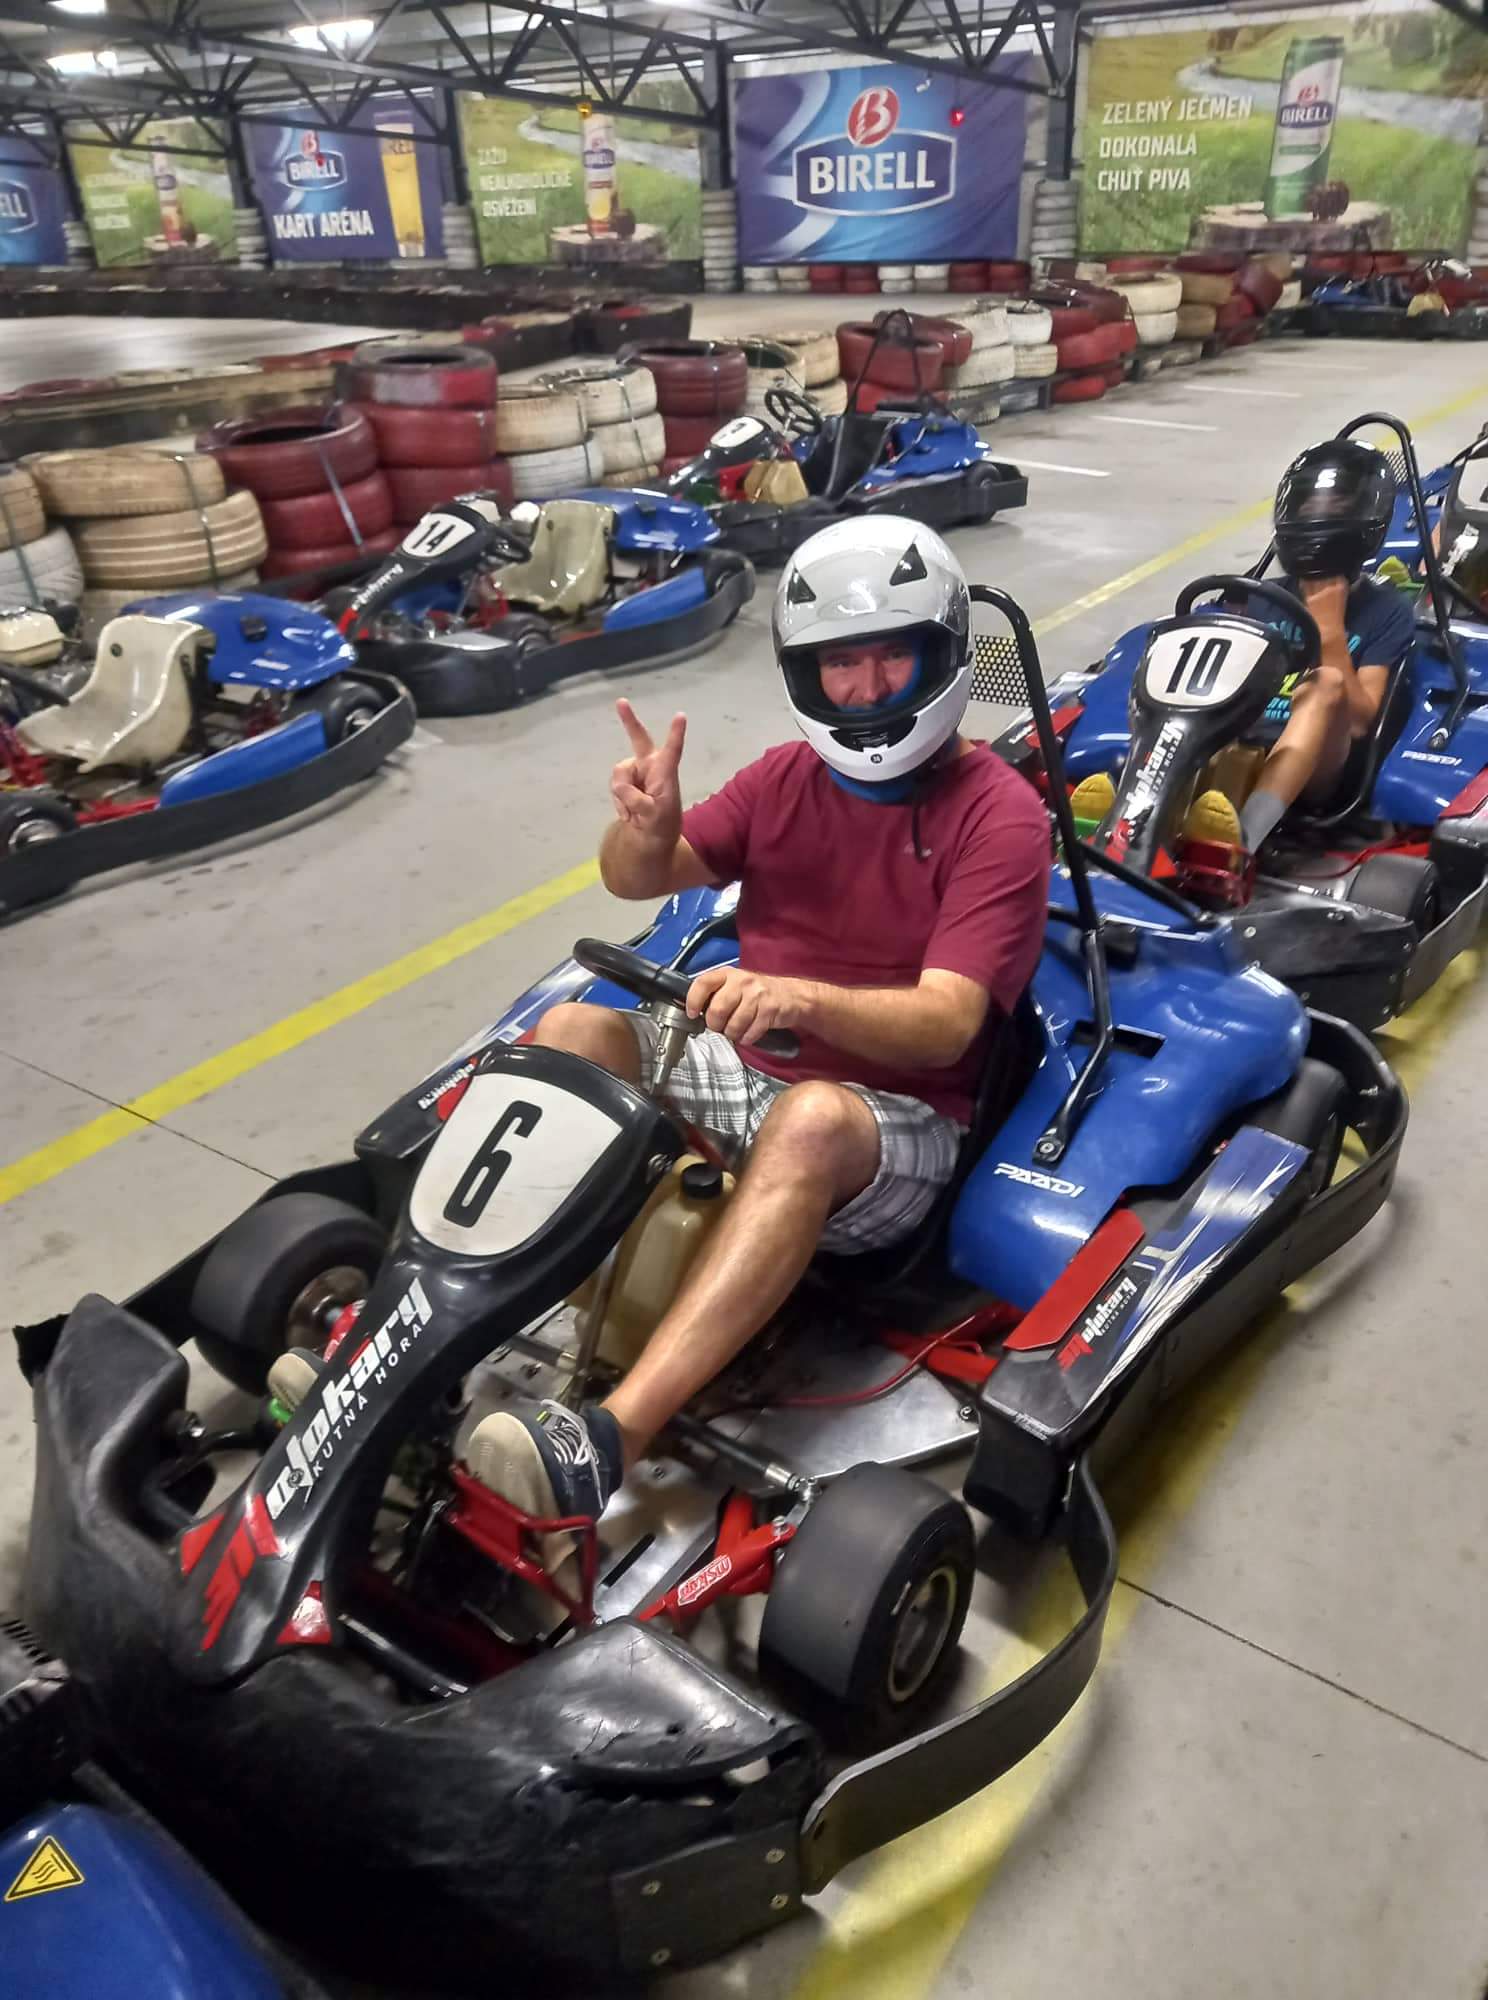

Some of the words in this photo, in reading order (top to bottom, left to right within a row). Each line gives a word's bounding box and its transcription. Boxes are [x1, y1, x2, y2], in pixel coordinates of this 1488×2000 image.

[1102, 96, 1172, 125] ZELENÝ
[1281, 106, 1328, 123] BIRELL
[1100, 129, 1197, 159] DOKONALÁ
[809, 150, 936, 194] BIRELL
[1149, 168, 1191, 190] PIVA
[273, 214, 315, 239] KART
[320, 208, 375, 238] ARÉNA
[411, 520, 456, 553] 14
[1166, 637, 1233, 697] 10
[443, 1100, 543, 1228] 6
[374, 1322, 423, 1385] HORA
